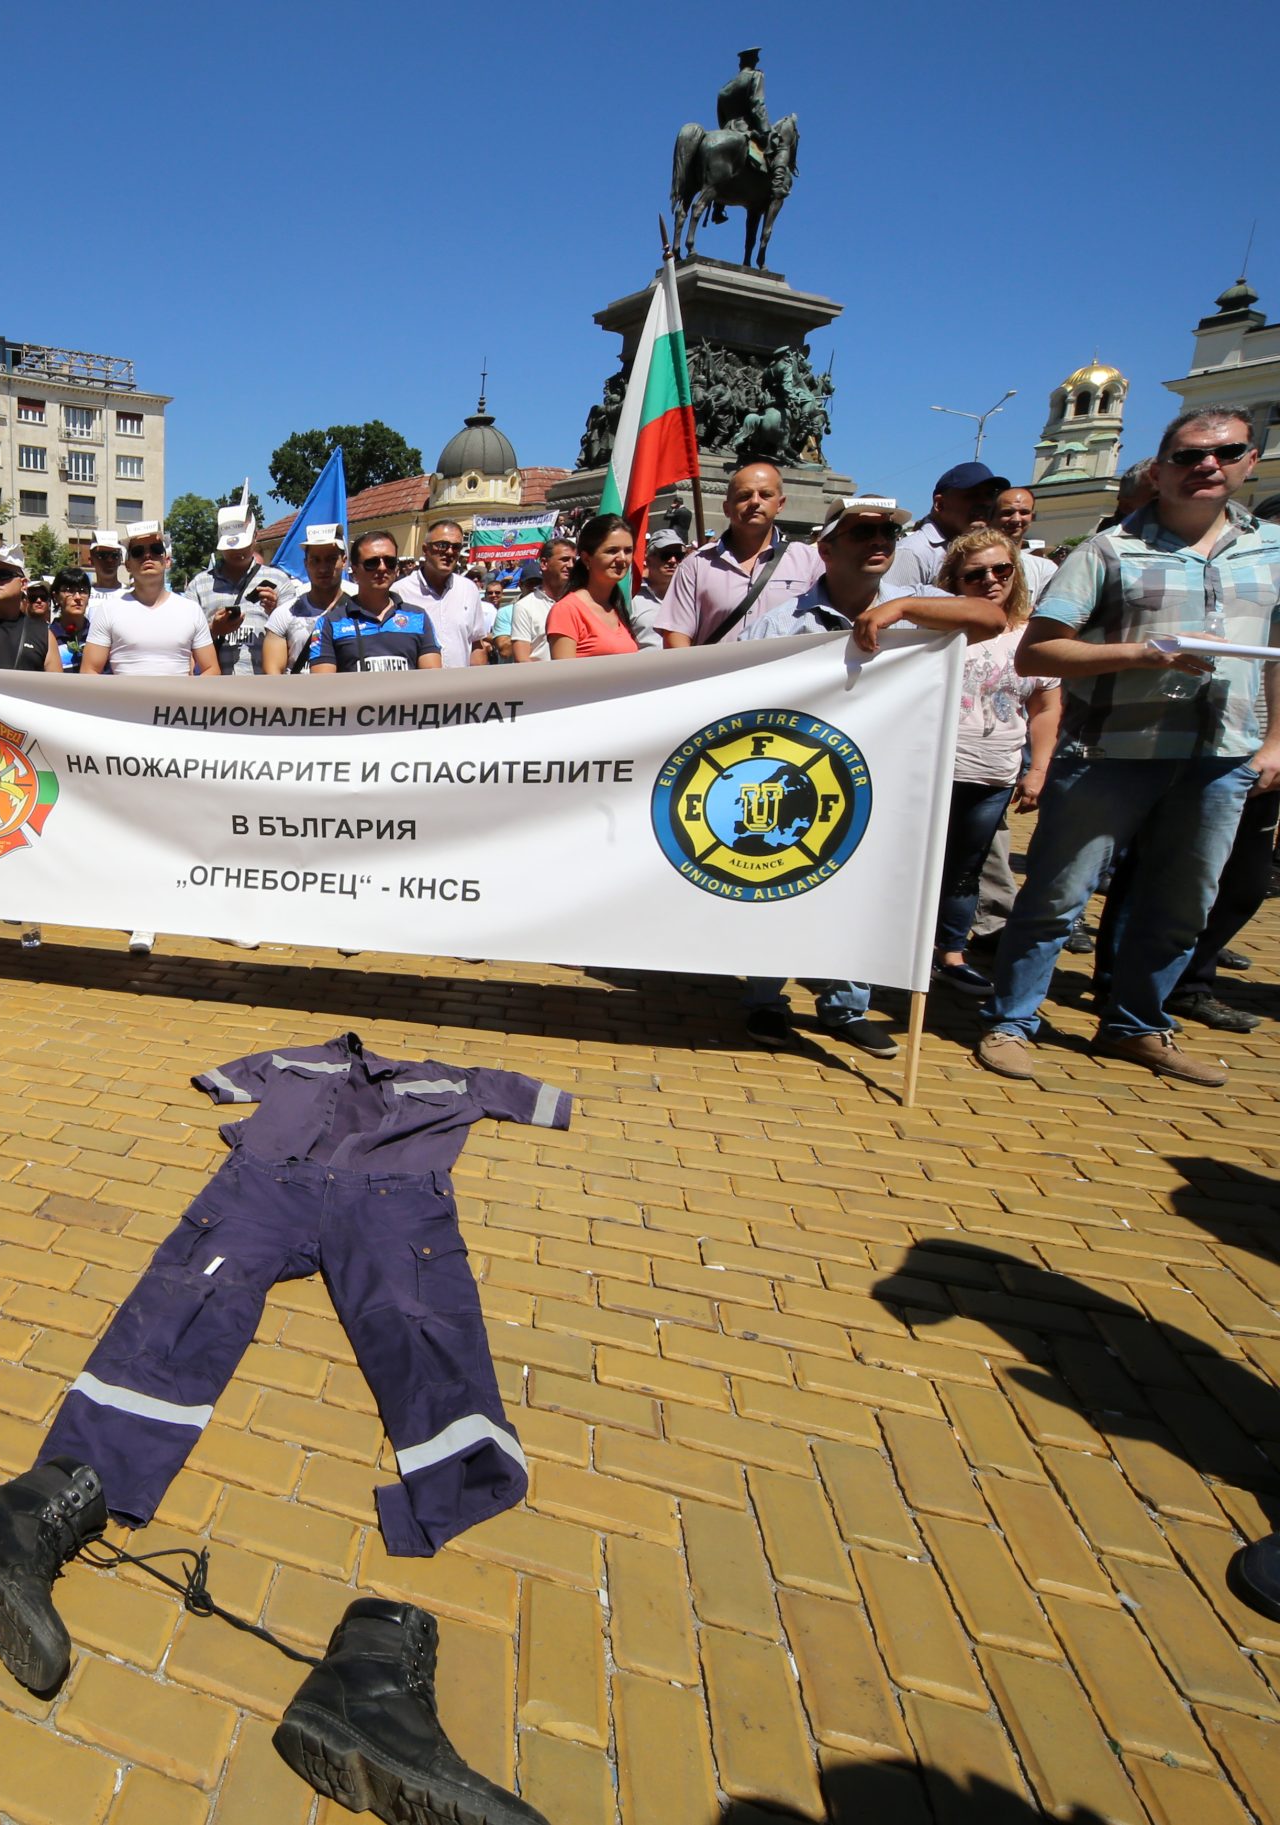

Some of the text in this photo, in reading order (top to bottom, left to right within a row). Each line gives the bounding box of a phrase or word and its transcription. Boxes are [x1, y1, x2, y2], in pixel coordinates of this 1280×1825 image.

[153, 700, 524, 730] НАЦИОНАЛЕН СИНДИКАТ
[659, 713, 868, 788] EUROPEAN FIRE FIGHTER
[750, 736, 774, 756] F
[66, 754, 634, 784] НА ПОЖАРНИКАРИТЕ И СПАСИТЕЛИТЕ
[684, 794, 702, 822] E
[739, 783, 783, 833] U
[818, 794, 840, 822] F
[231, 814, 417, 840] В БЪЛГАРИЯ
[679, 859, 840, 900] UNIONS ALLIANCE
[728, 858, 785, 871] ALLIANCE
[176, 865, 373, 900] „ОГНЕБОРЕЦ“
[399, 876, 481, 902] КНСБ
